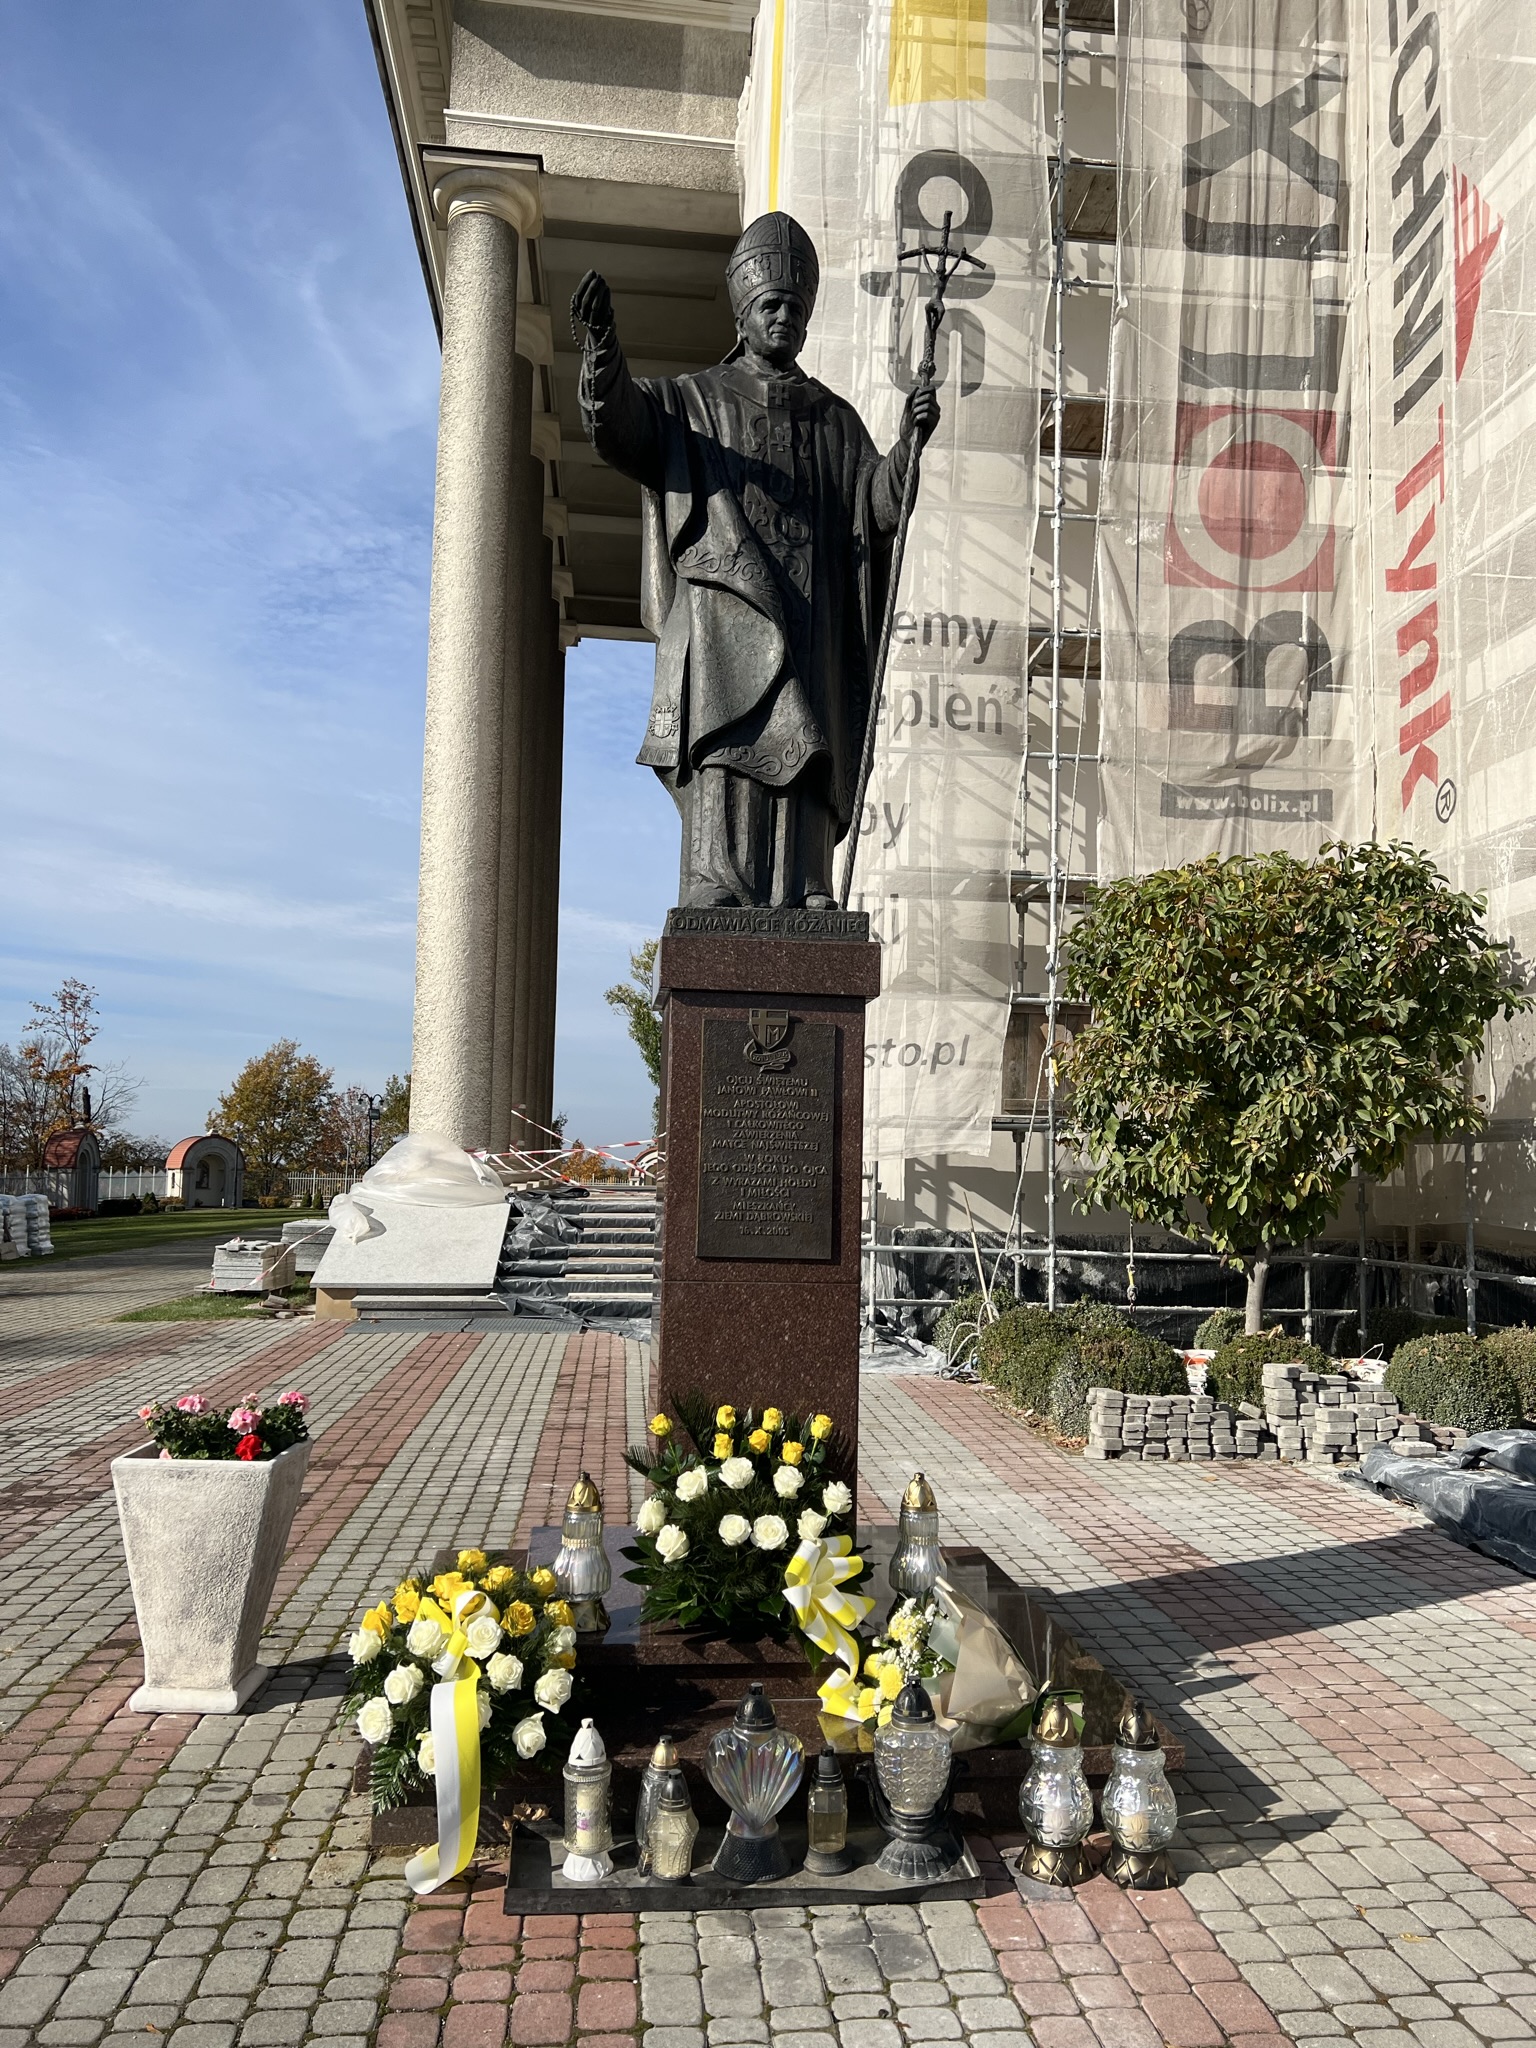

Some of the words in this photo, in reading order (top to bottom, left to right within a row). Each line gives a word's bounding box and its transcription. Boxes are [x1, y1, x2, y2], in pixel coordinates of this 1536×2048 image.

[1164, 32, 1340, 770] BOLIX
[1175, 789, 1319, 818] www.bolix.pl
[672, 916, 779, 934] ODMAWIAJCIE
[864, 1034, 970, 1075] sto.pl
[726, 1075, 753, 1086] OJCU
[717, 1085, 757, 1096] JANOWI
[761, 1086, 808, 1097] PAWŁOWI
[810, 1088, 818, 1097] II
[733, 1099, 799, 1110] APOSTOŁOWI
[703, 1109, 758, 1119] MODLITWY
[734, 1119, 805, 1130] CAŁKOWITEGO
[732, 1129, 799, 1140] ZAWIERZENIA
[712, 1140, 747, 1150] MATCE
[758, 1153, 789, 1164] ROKU
[703, 1163, 729, 1173] JEGO
[782, 1164, 799, 1174] DO
[802, 1164, 829, 1176] OJCA
[711, 1177, 720, 1187] Z
[723, 1177, 778, 1188] WYRAZAMI
[714, 1211, 744, 1221] ZIEMI
